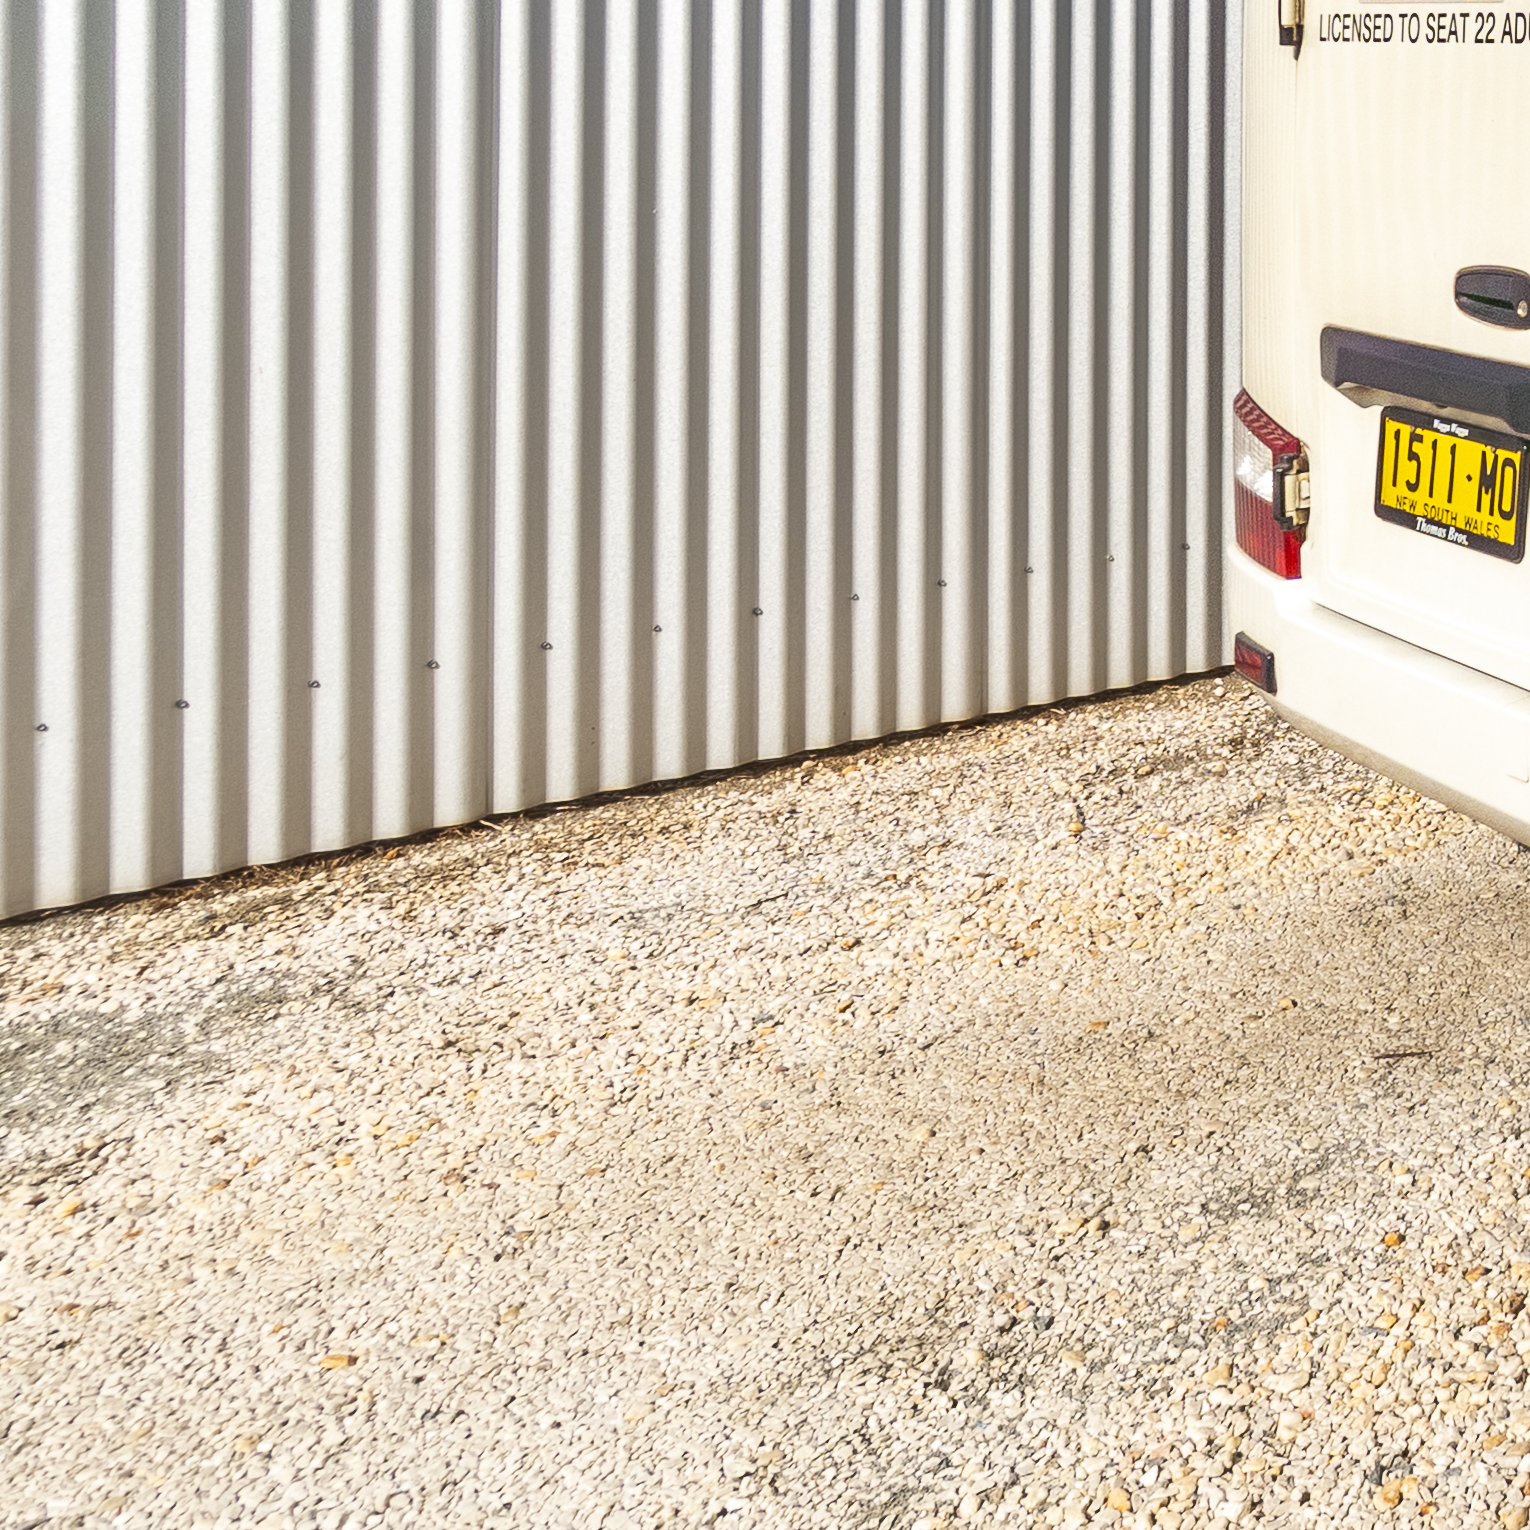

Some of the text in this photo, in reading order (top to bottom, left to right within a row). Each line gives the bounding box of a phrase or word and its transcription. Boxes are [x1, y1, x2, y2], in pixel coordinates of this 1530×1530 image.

[1319, 13, 1393, 43] LICENSED
[1399, 13, 1420, 43] TO
[1425, 12, 1470, 44] SEAT
[1474, 12, 1496, 44] 22
[1396, 494, 1500, 540] NEW SOUTH WALES
[1416, 517, 1447, 539] Thomas
